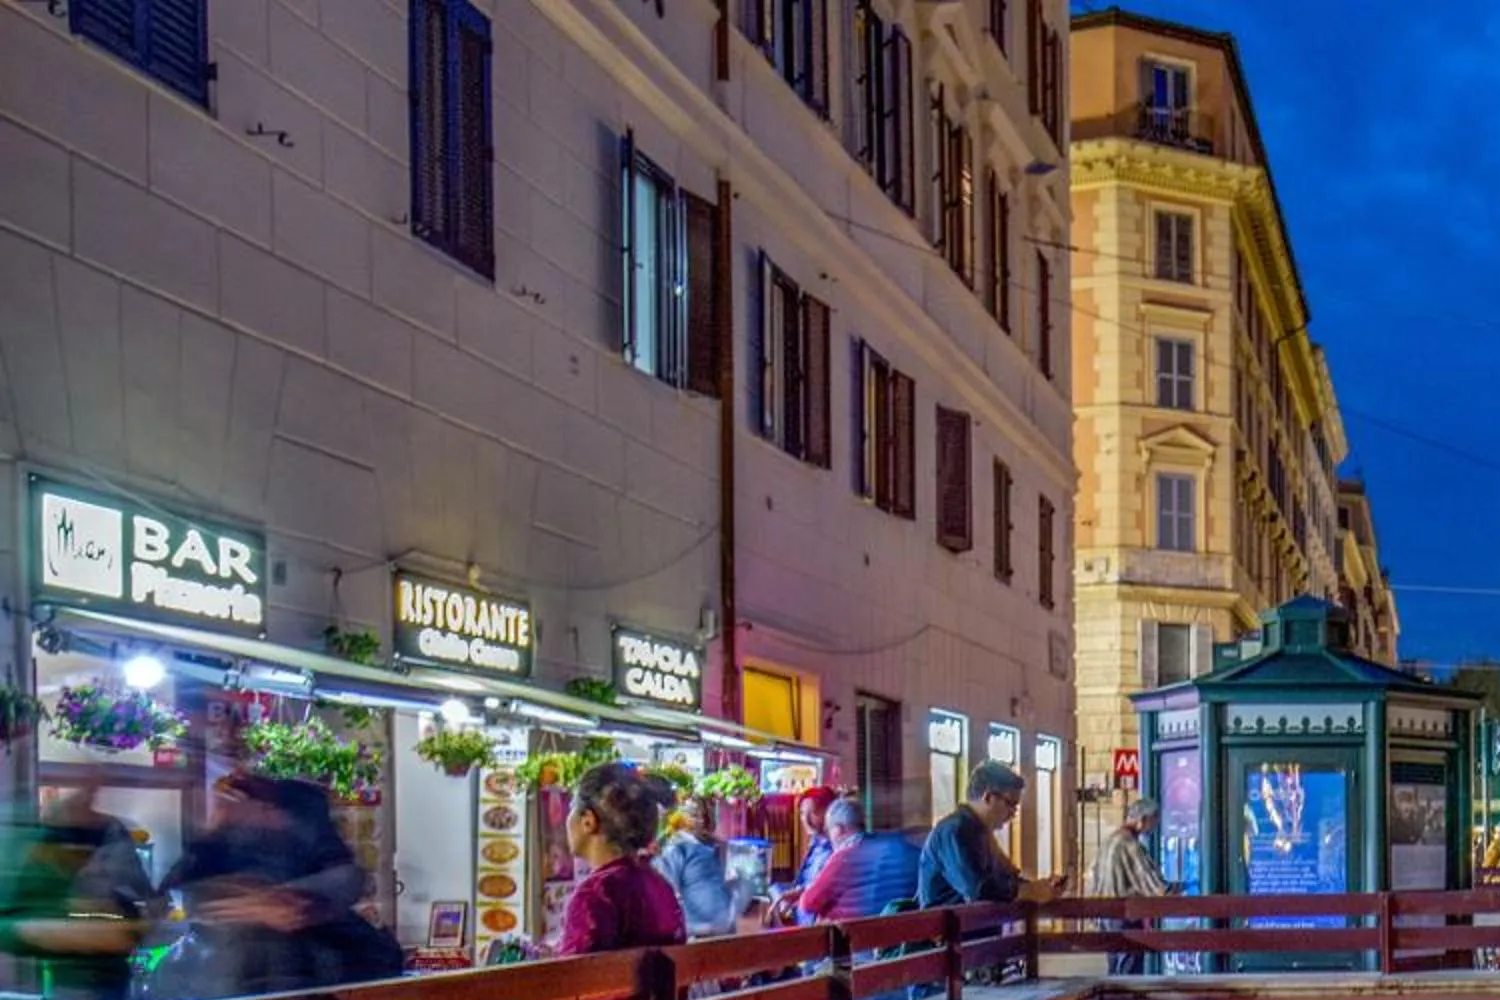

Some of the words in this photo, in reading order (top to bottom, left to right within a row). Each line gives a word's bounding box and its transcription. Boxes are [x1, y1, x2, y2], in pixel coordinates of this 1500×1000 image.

[132, 515, 258, 584] BAR
[400, 580, 529, 647] RISTORANTE
[619, 636, 699, 677] TAVOLA
[626, 667, 695, 705] CALDA
